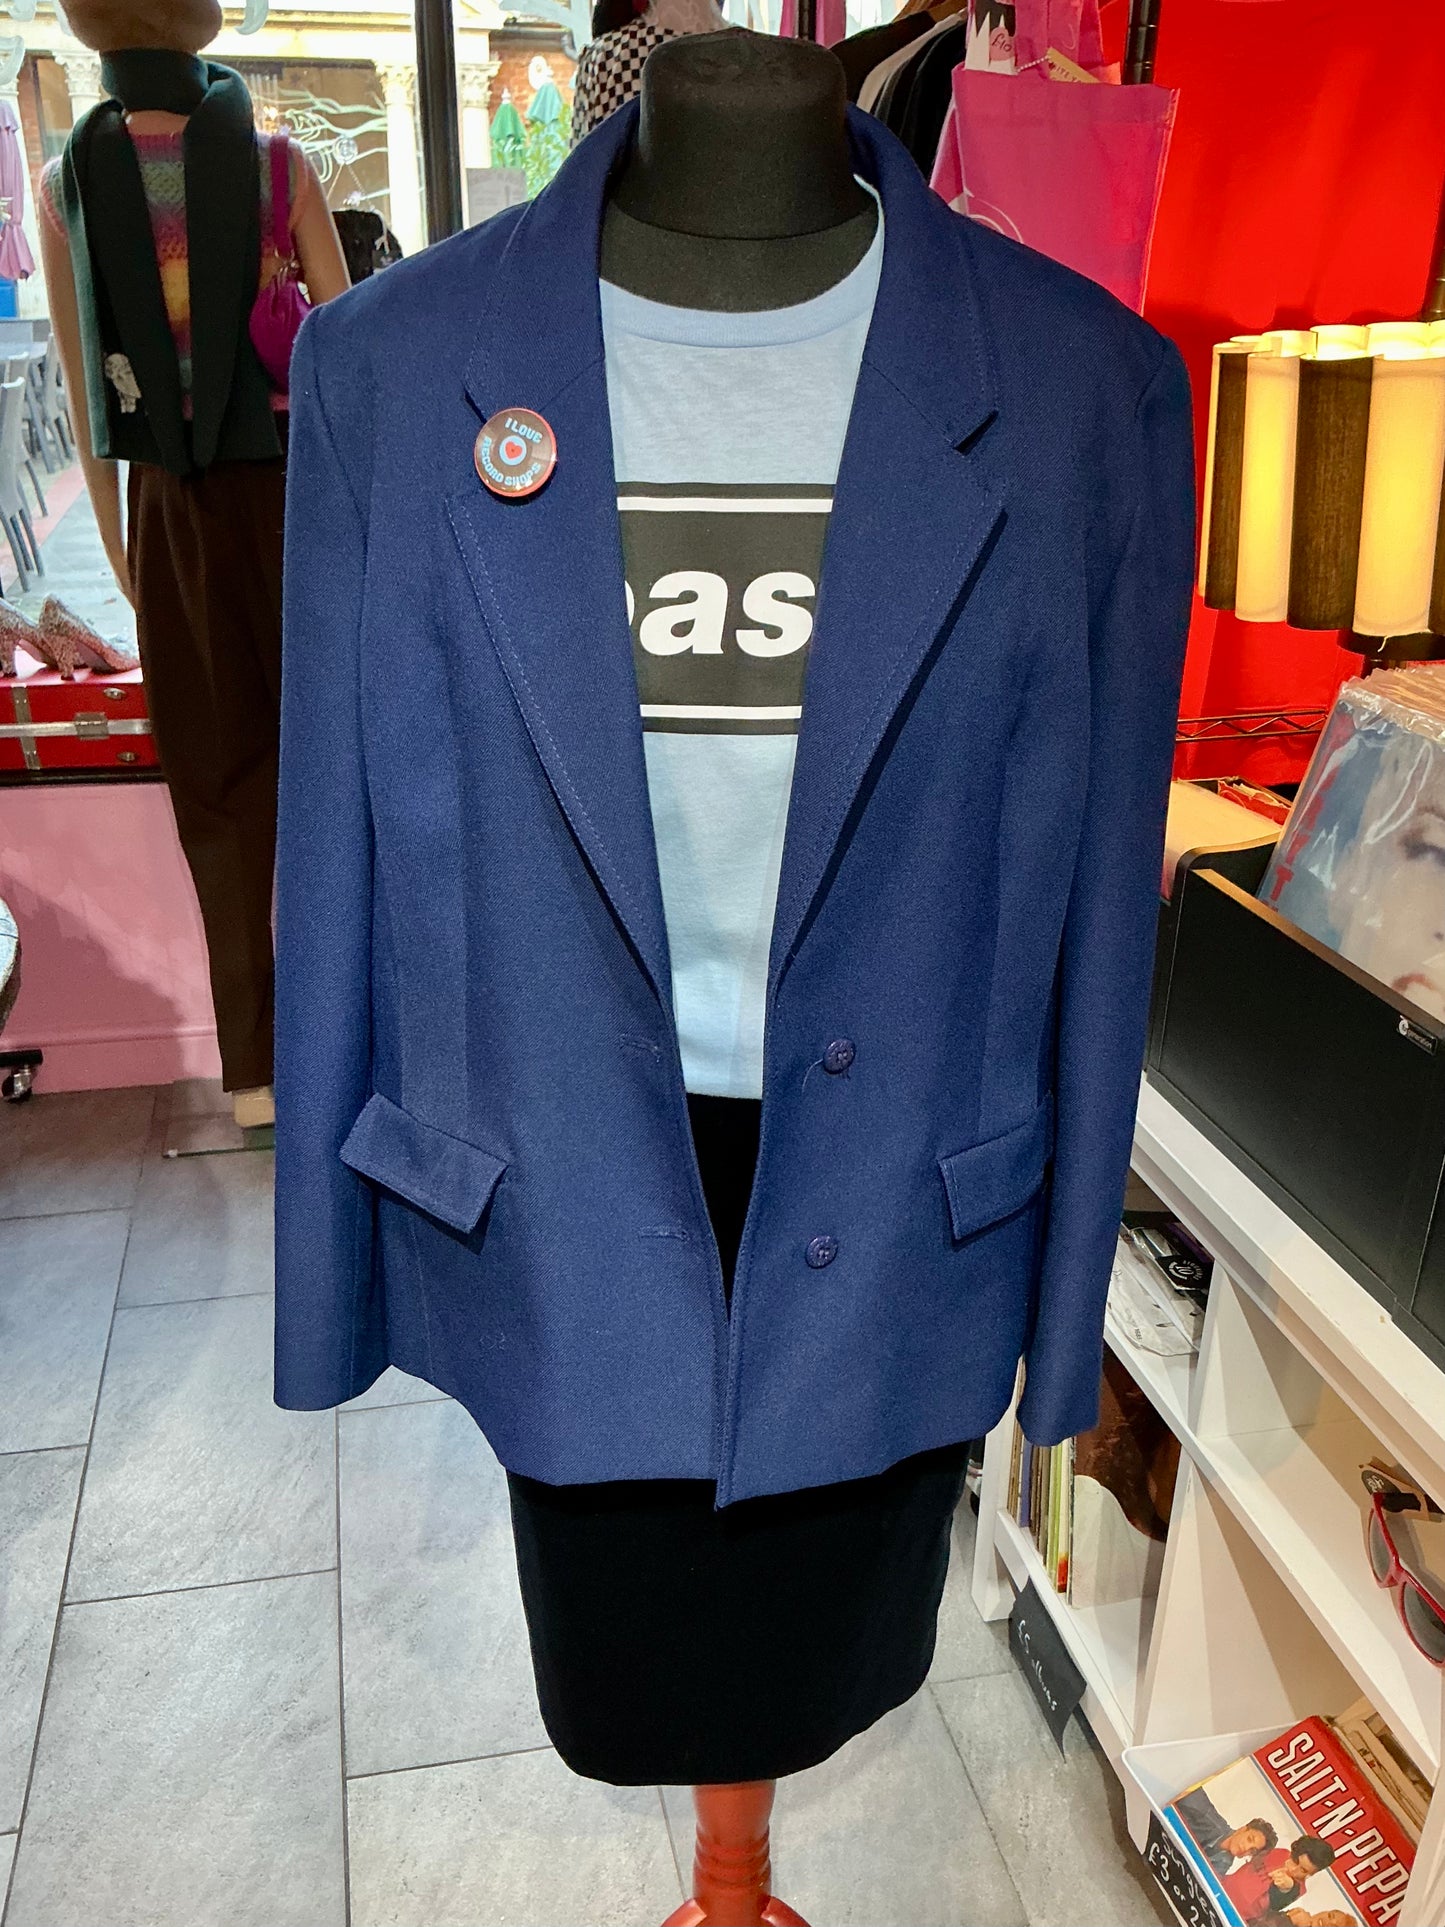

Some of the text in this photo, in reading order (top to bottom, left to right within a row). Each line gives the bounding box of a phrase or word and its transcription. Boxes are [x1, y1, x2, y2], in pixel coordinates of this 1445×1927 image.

[505, 417, 543, 443] I LOVE
[482, 436, 541, 486] RECORD SHOPS
[625, 570, 816, 658] as
[1149, 1842, 1170, 1882] £3
